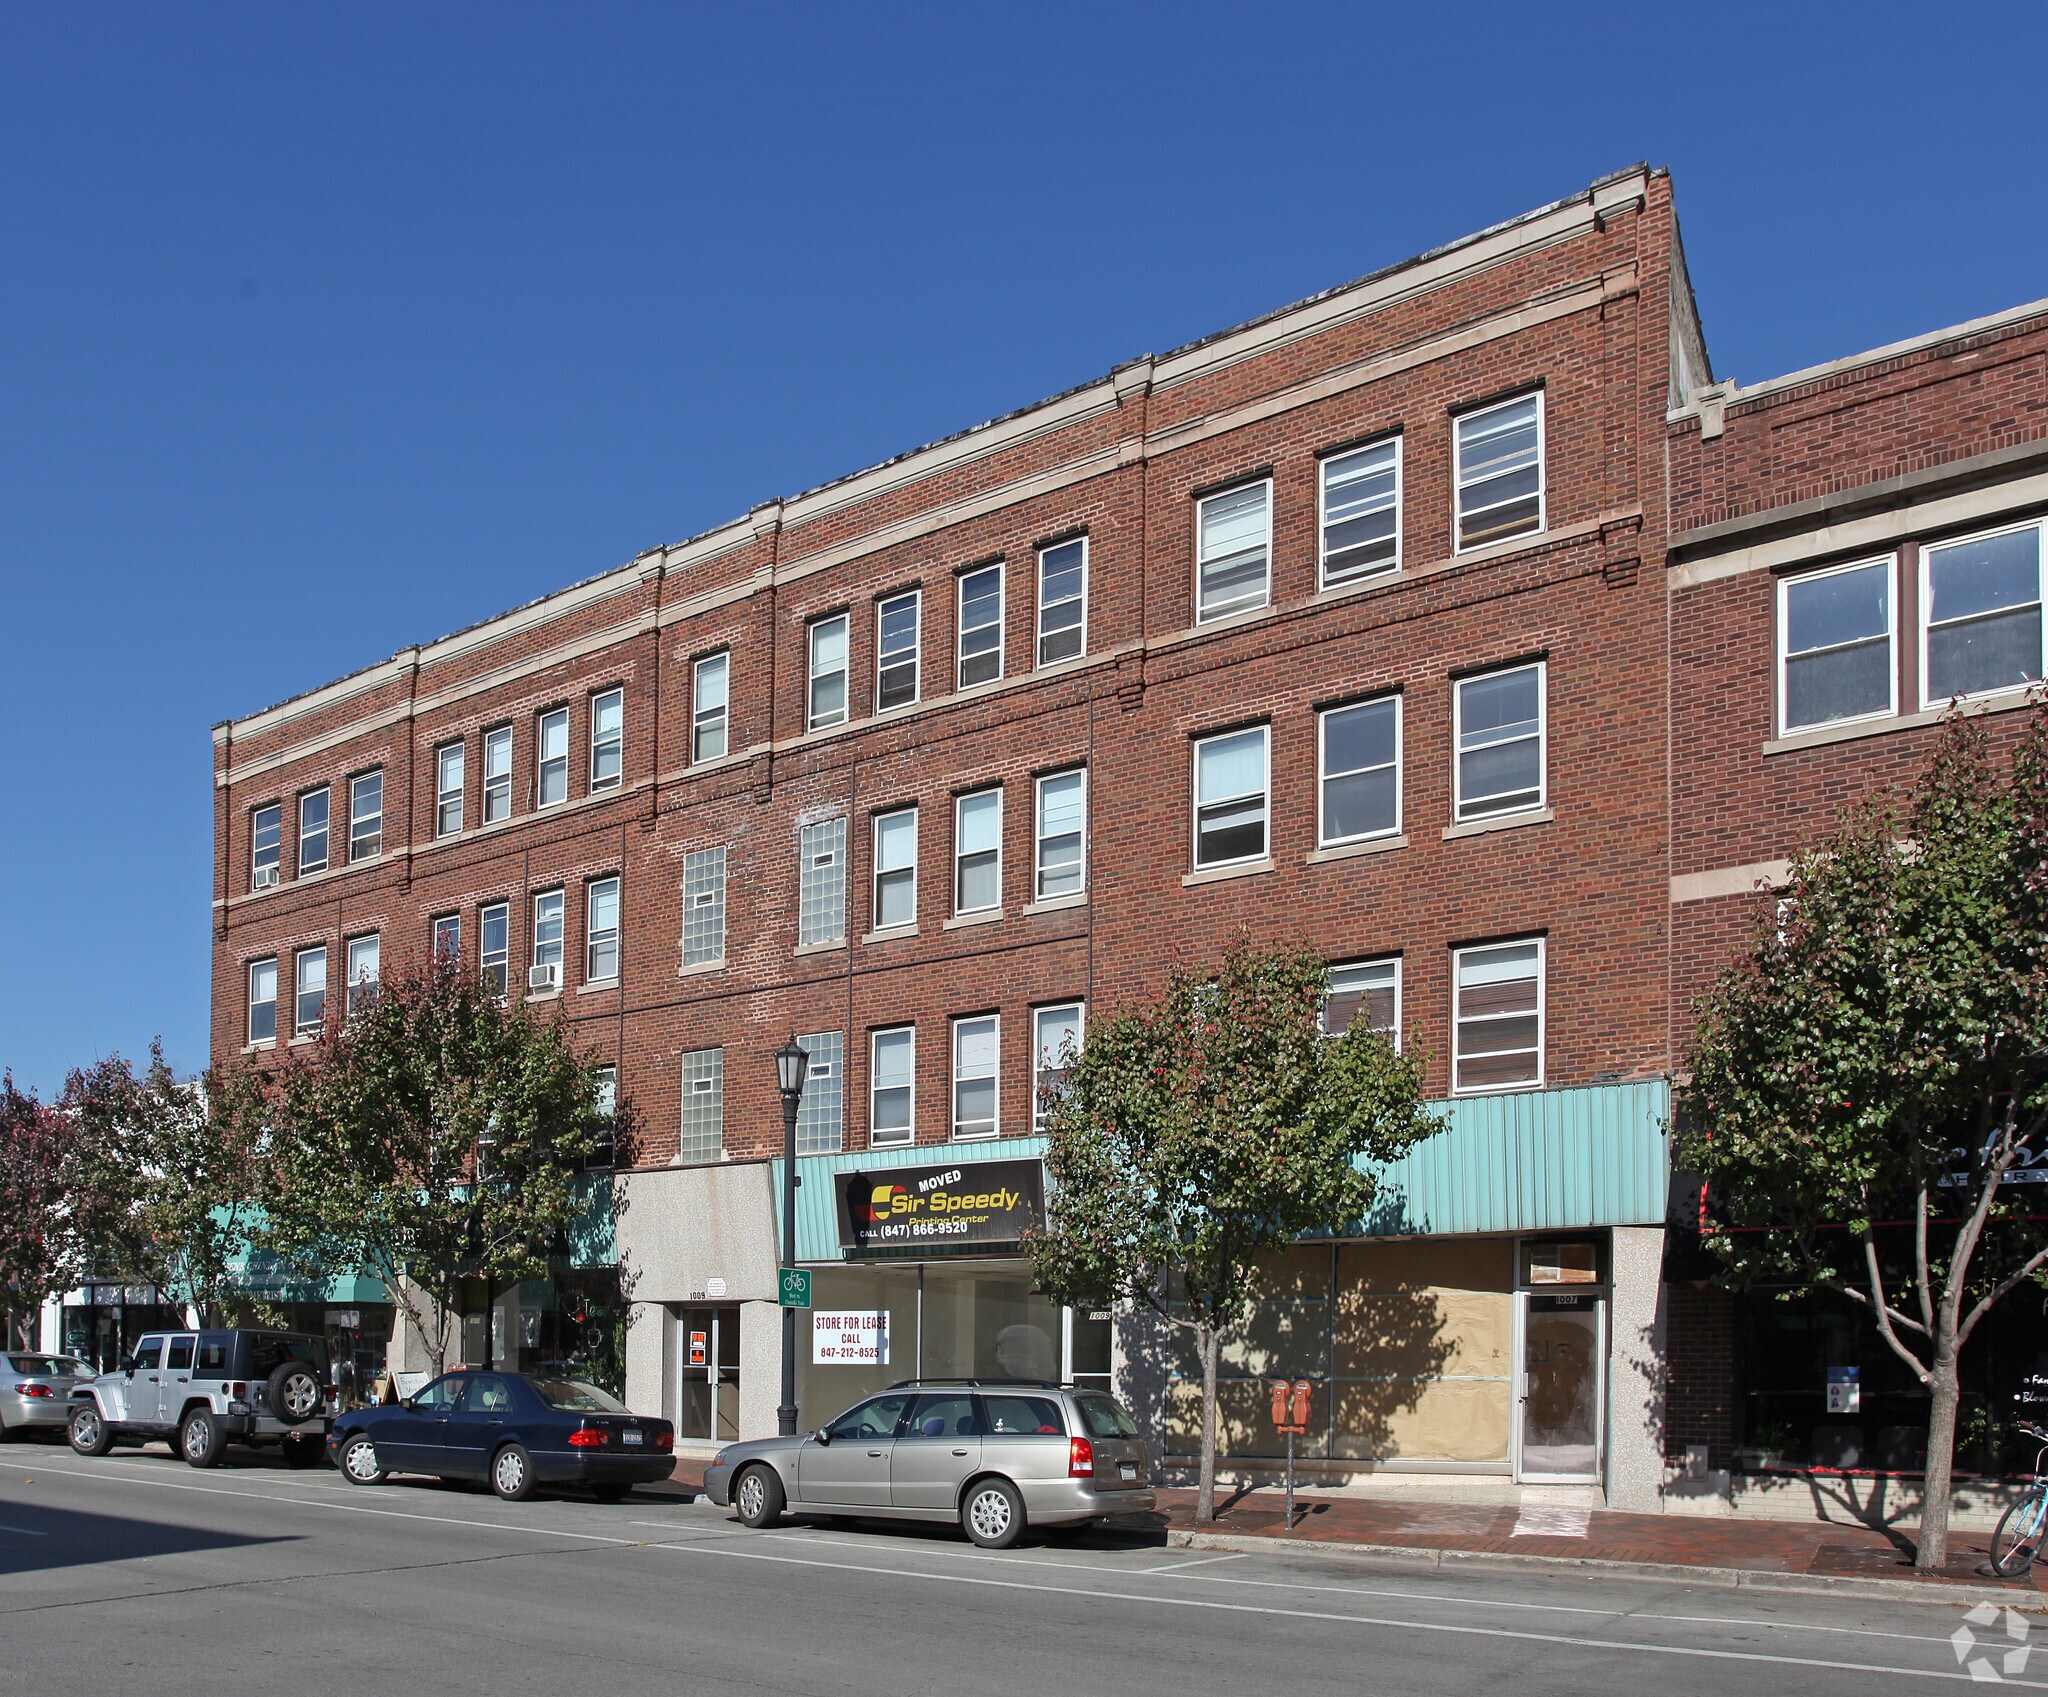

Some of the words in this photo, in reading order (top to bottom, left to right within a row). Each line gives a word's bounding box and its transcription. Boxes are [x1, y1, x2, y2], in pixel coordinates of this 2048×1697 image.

[918, 1169, 962, 1193] MOVED
[891, 1194, 925, 1214] Sir
[929, 1187, 1019, 1213] Speedy
[908, 1216, 951, 1227] Printing
[951, 1214, 990, 1225] Center
[859, 1229, 879, 1238] CALL
[880, 1223, 910, 1239] (847)
[912, 1221, 968, 1236] 866-9520
[689, 1291, 706, 1300] 1009
[1556, 1295, 1576, 1303] 1007
[816, 1316, 842, 1330] STORE
[843, 1316, 860, 1330] FOR
[862, 1316, 887, 1330] LEASE
[841, 1333, 861, 1344] CALL
[820, 1347, 880, 1358] 847-212-8525
